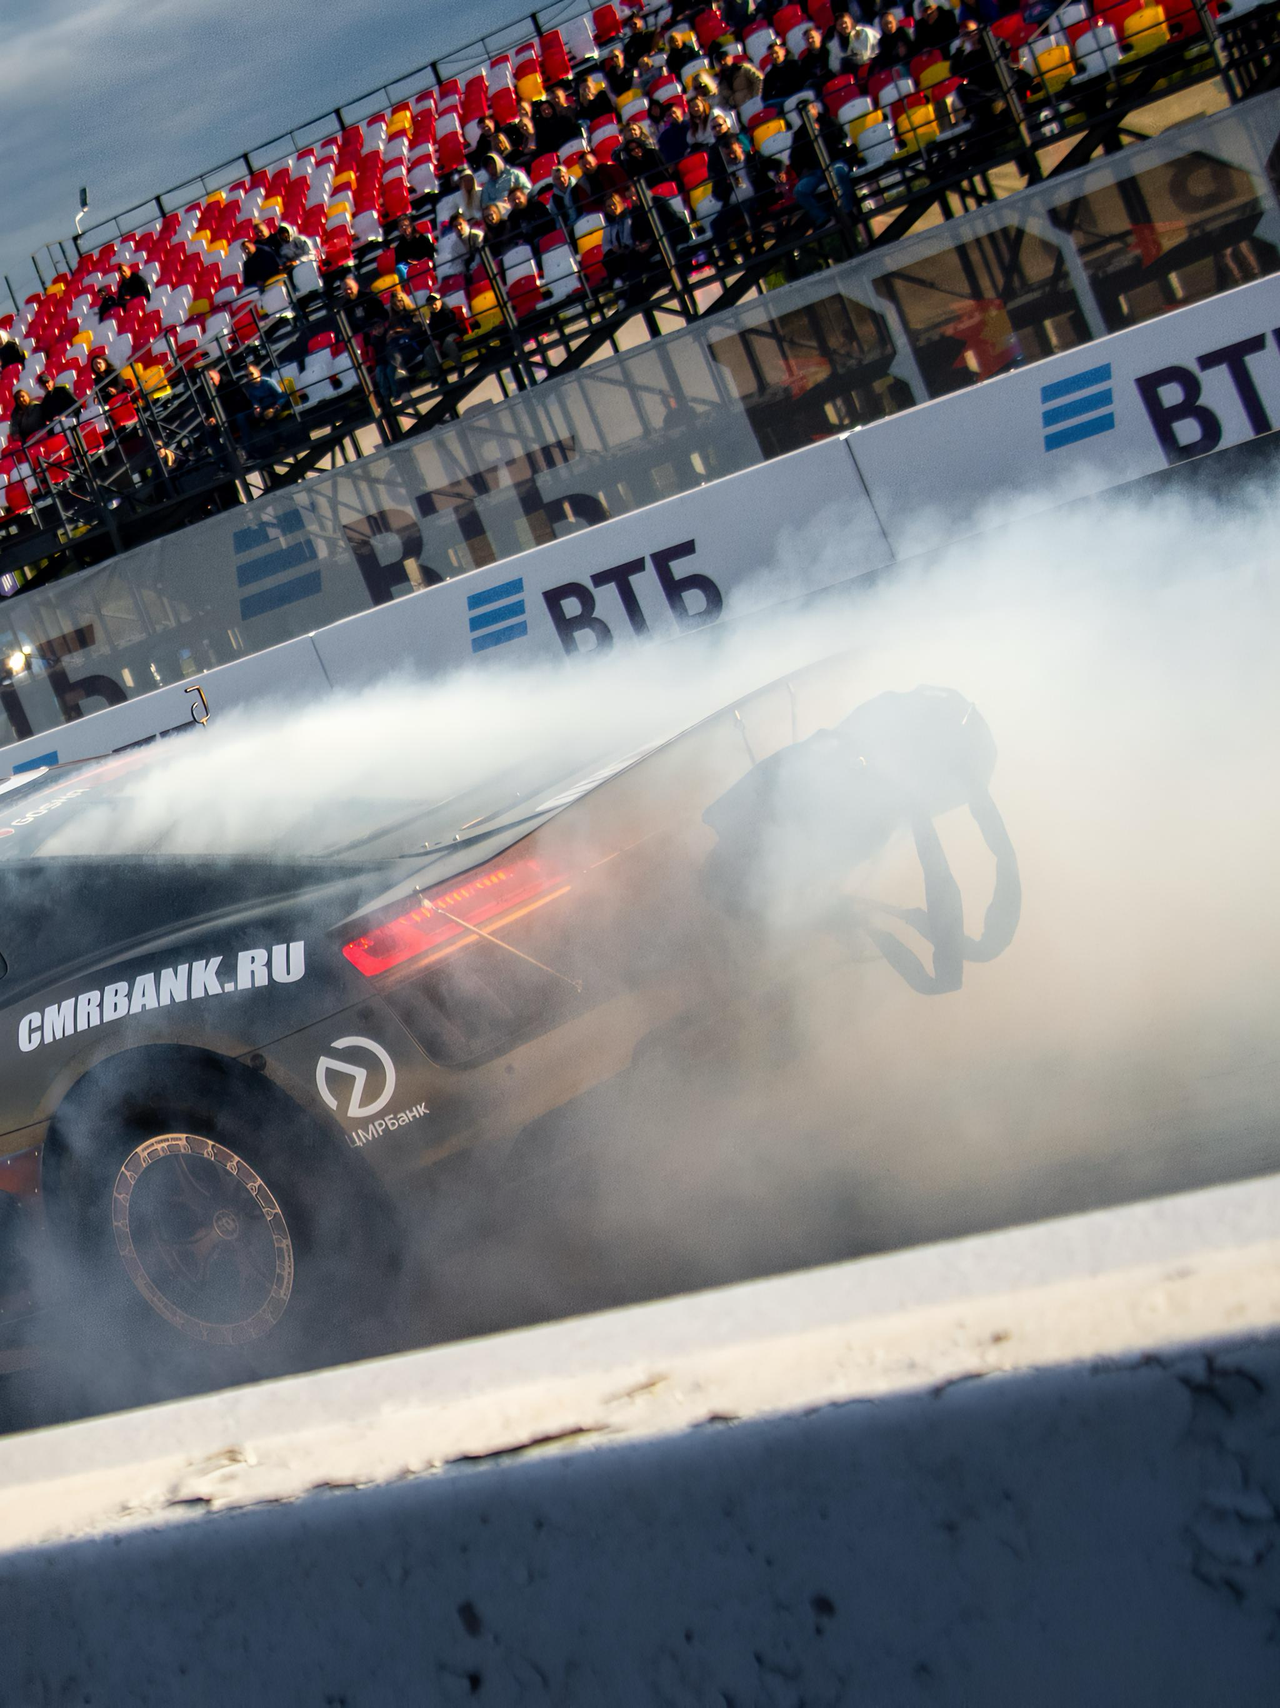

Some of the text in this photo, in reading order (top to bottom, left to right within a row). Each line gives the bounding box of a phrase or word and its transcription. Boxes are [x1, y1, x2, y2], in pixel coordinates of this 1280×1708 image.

[1133, 325, 1280, 467] ВТ
[542, 538, 724, 660] ВТБ
[18, 940, 306, 1053] CMRBANK.RU
[344, 1102, 430, 1149] ЦМРБанк
